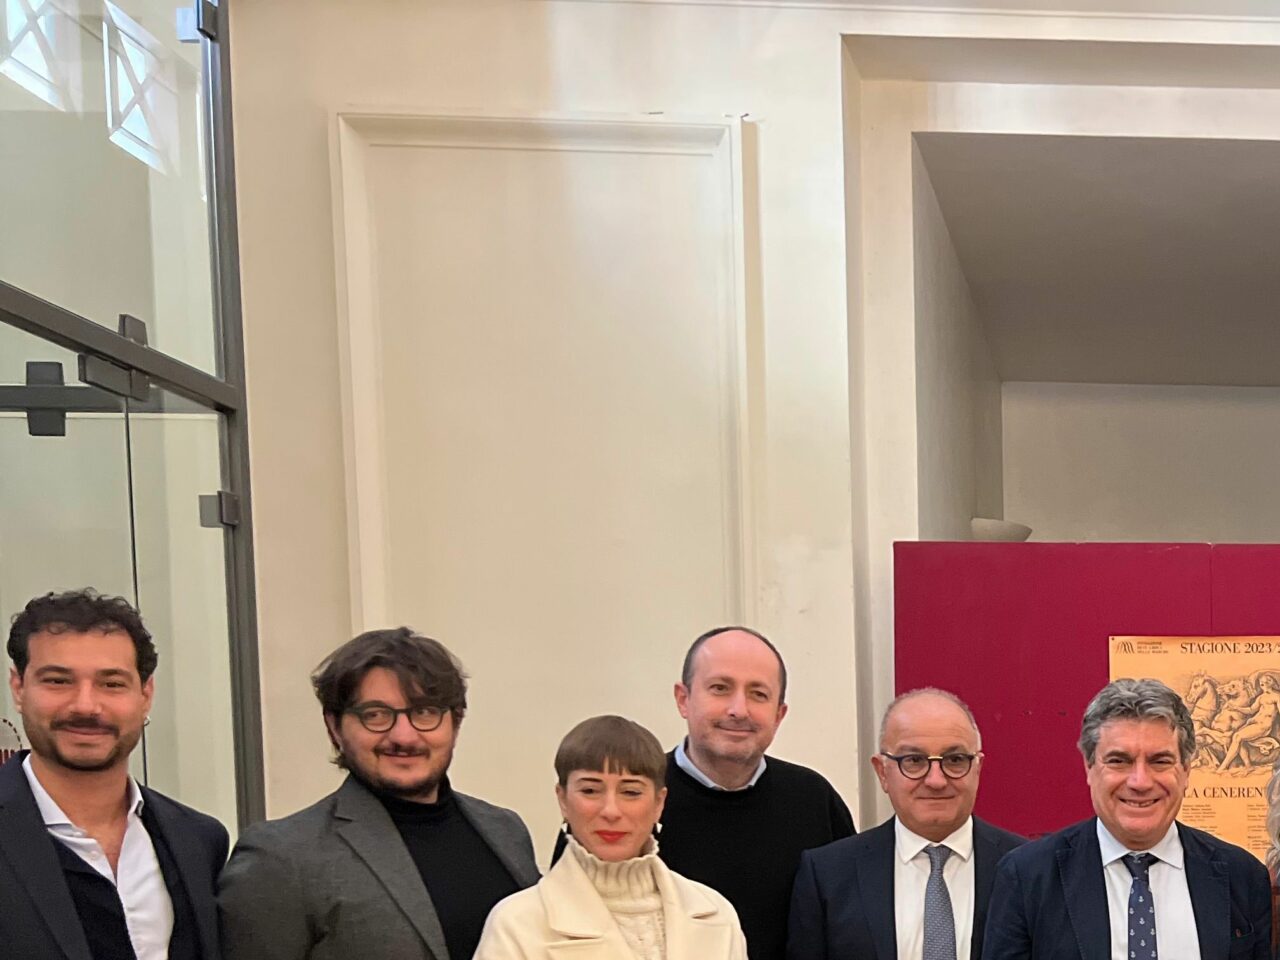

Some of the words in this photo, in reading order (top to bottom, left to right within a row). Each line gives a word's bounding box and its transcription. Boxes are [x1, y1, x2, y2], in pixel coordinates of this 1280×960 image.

[1180, 642, 1241, 654] STAGIONE
[1183, 787, 1199, 799] LA
[1203, 787, 1267, 799] CENEREN
